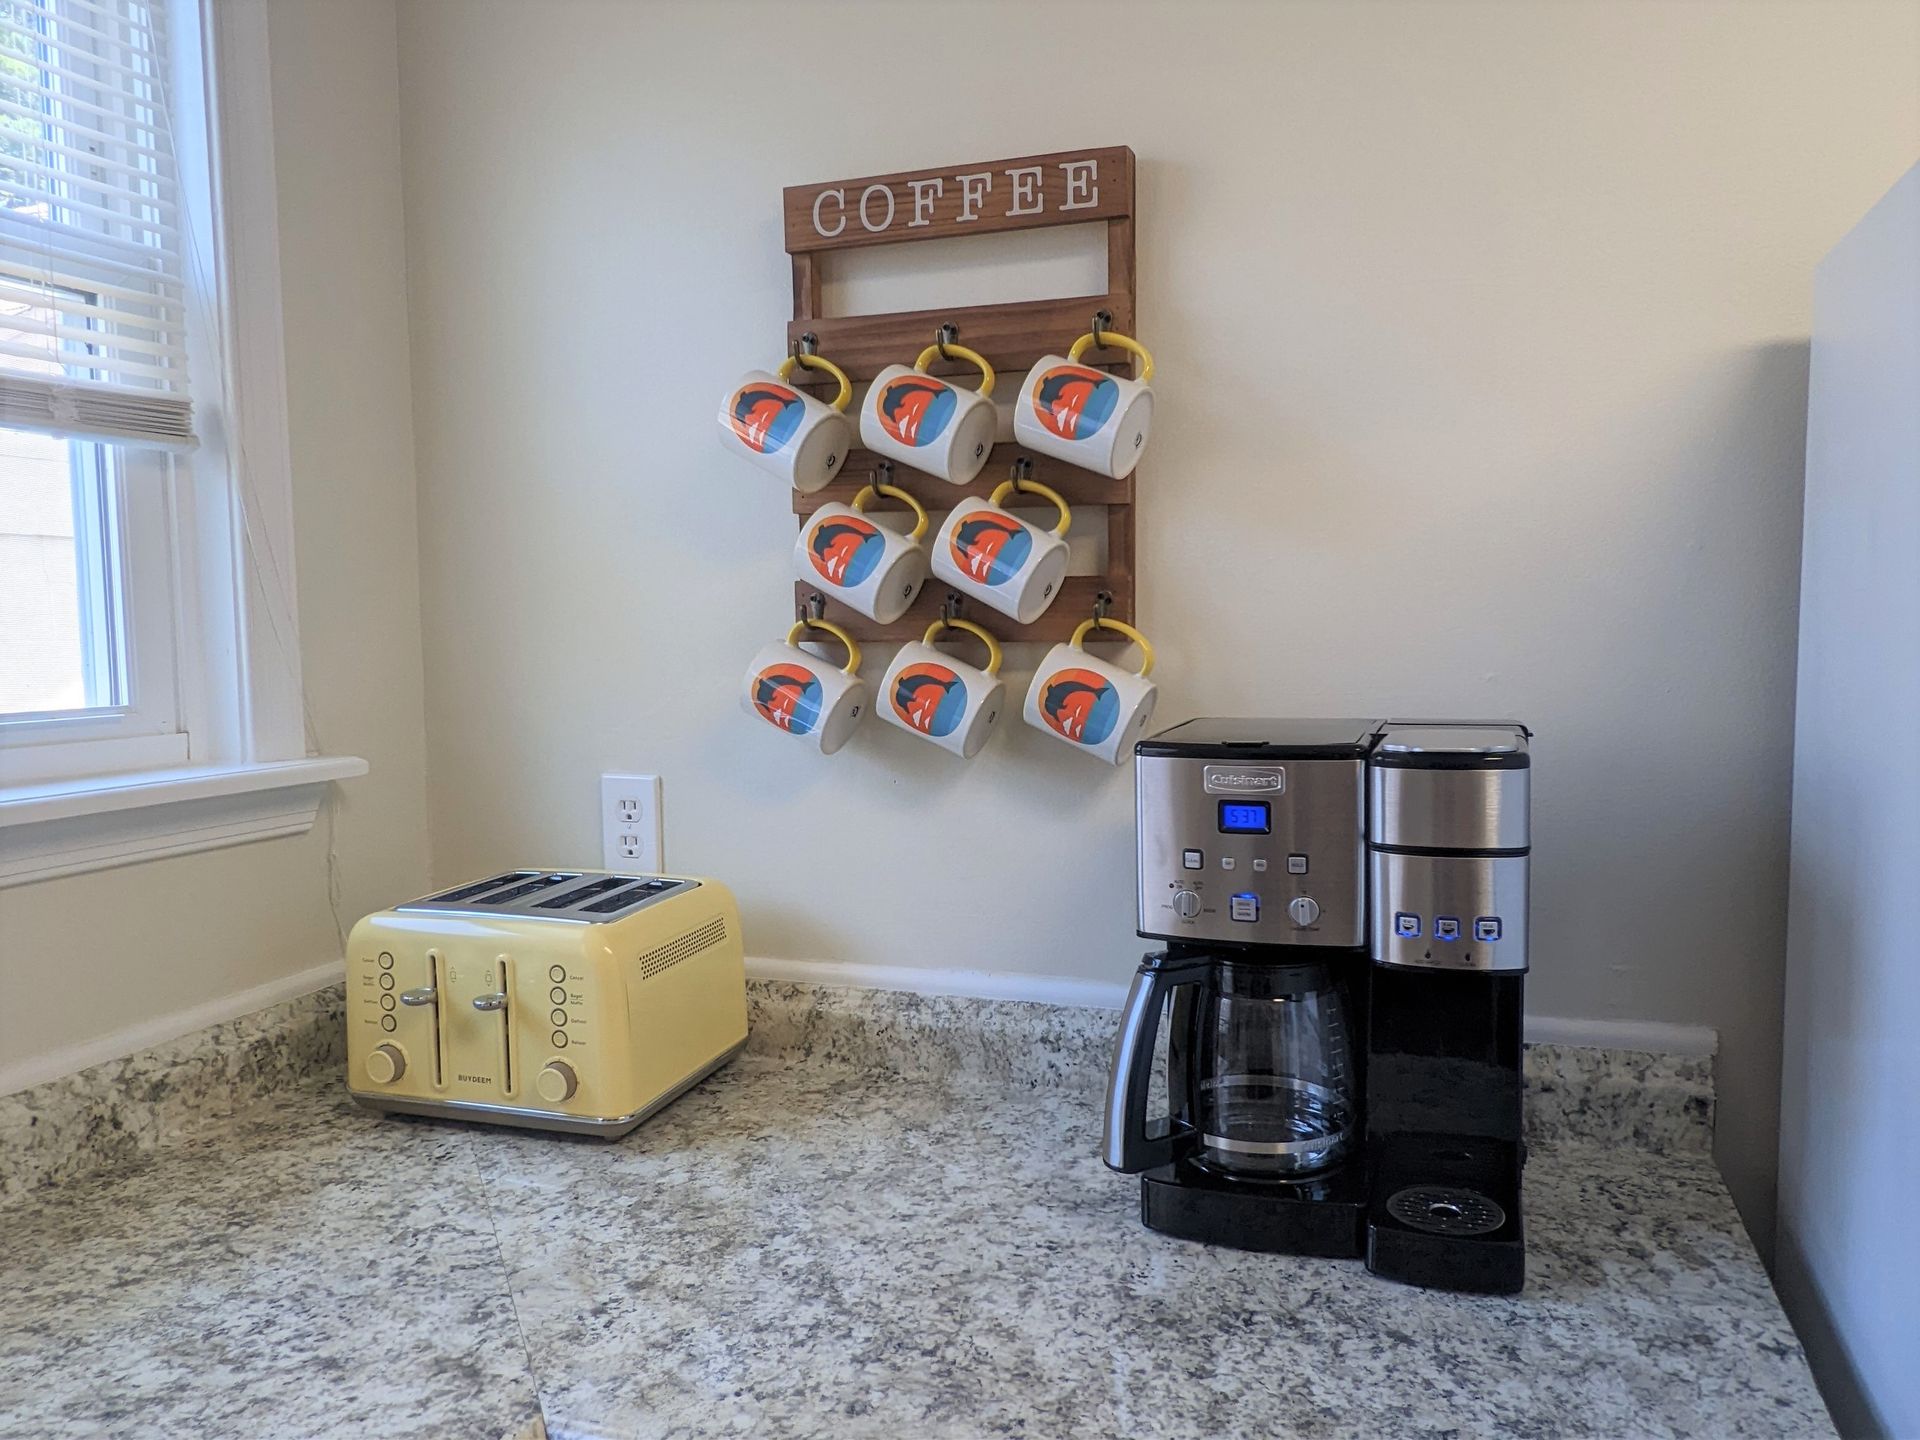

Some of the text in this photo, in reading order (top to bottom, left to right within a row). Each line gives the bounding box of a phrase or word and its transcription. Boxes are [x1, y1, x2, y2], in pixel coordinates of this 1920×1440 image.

[812, 159, 1099, 238] COFFEE
[1211, 774, 1278, 786] Cuisinart
[458, 1074, 492, 1084] BUYDEEM
